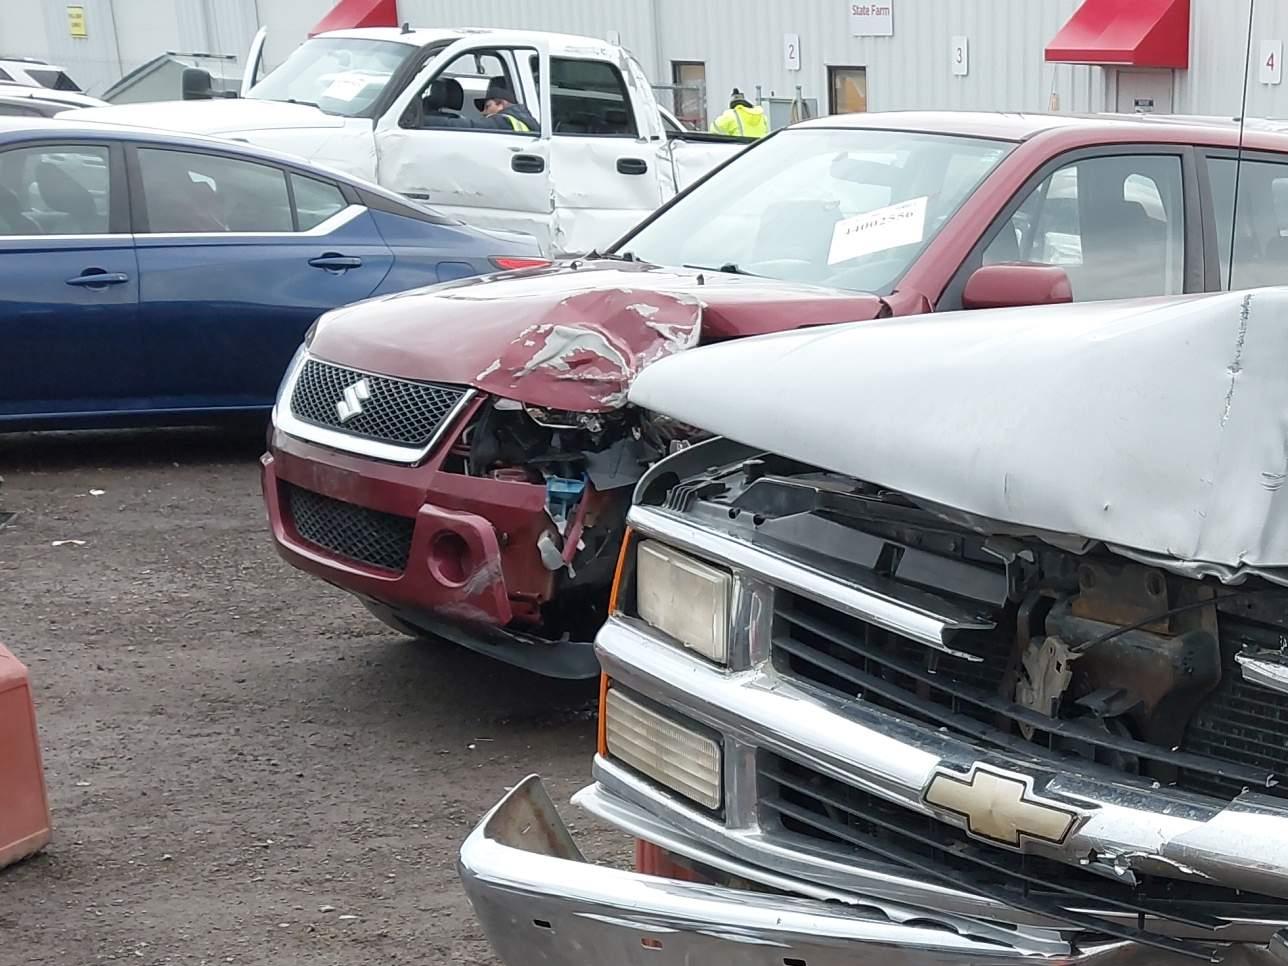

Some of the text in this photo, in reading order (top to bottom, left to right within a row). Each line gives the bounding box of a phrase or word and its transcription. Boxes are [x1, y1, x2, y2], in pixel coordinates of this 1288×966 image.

[852, 4, 890, 16] State Farm
[788, 44, 795, 59] 2
[956, 47, 962, 64] 3
[1265, 51, 1274, 72] 4
